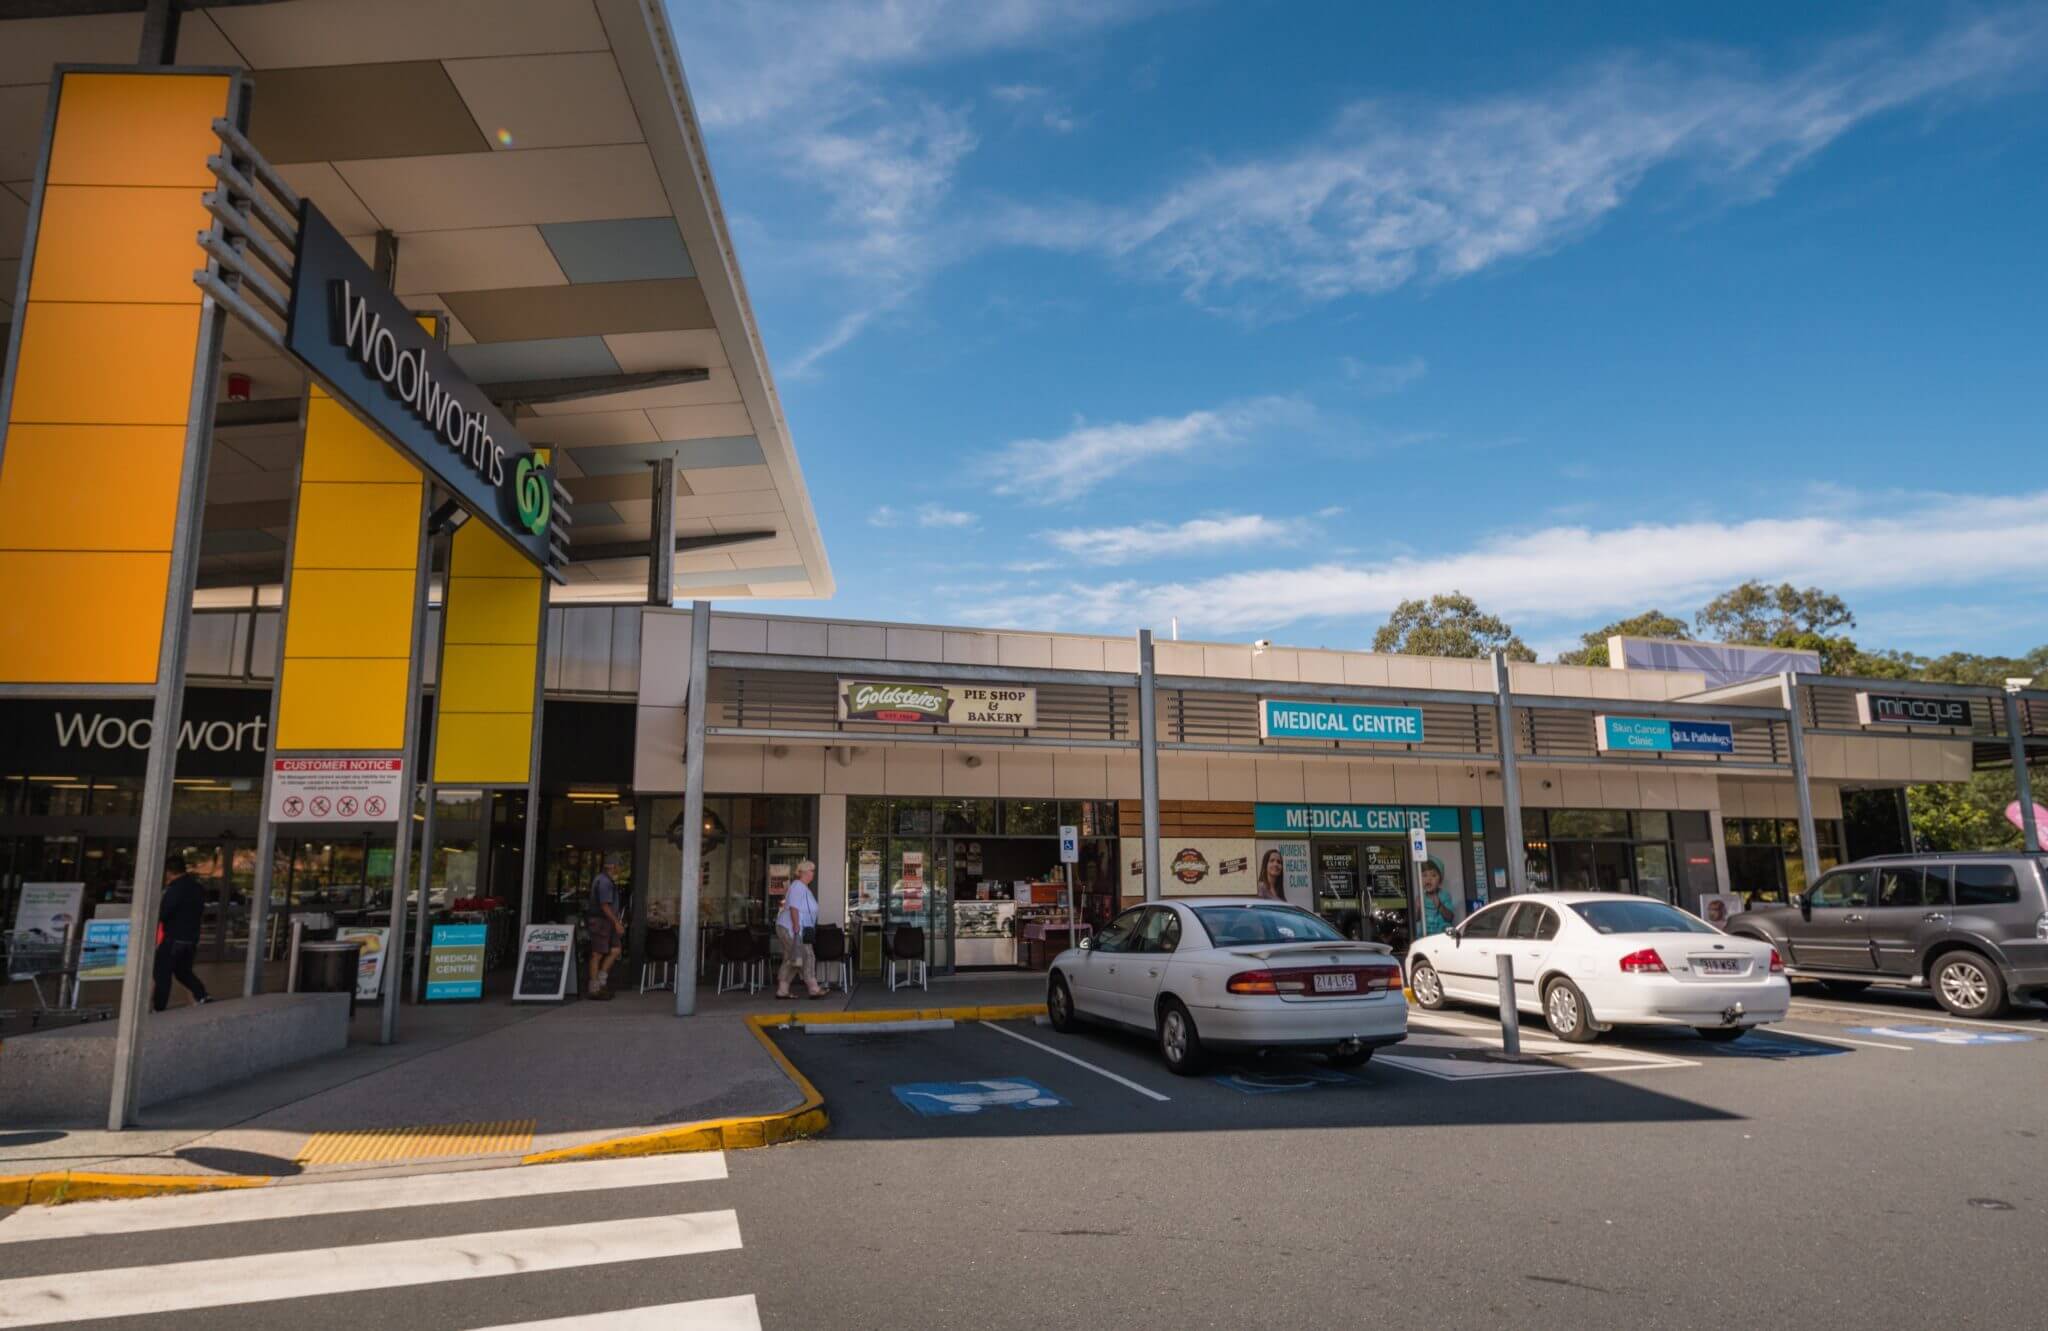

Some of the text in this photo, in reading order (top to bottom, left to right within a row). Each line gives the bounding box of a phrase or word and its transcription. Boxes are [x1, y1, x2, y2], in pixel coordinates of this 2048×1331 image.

[344, 279, 505, 487] Woolworths
[856, 686, 942, 711] Goldsteins
[964, 689, 1026, 701] PIE SHOP
[988, 701, 999, 711] &
[1877, 698, 1963, 724] minogue
[967, 712, 1023, 723] BAKERY
[1273, 710, 1416, 734] MEDICAL CENTRE
[1612, 722, 1666, 735] Skin Cancer
[1627, 735, 1654, 746] Clinic
[283, 760, 393, 770] CUSTOMER NOTICE
[1286, 809, 1430, 829] MEDICAL CENTRE
[435, 953, 480, 964] MEDICAL
[436, 964, 476, 974] CENTRE
